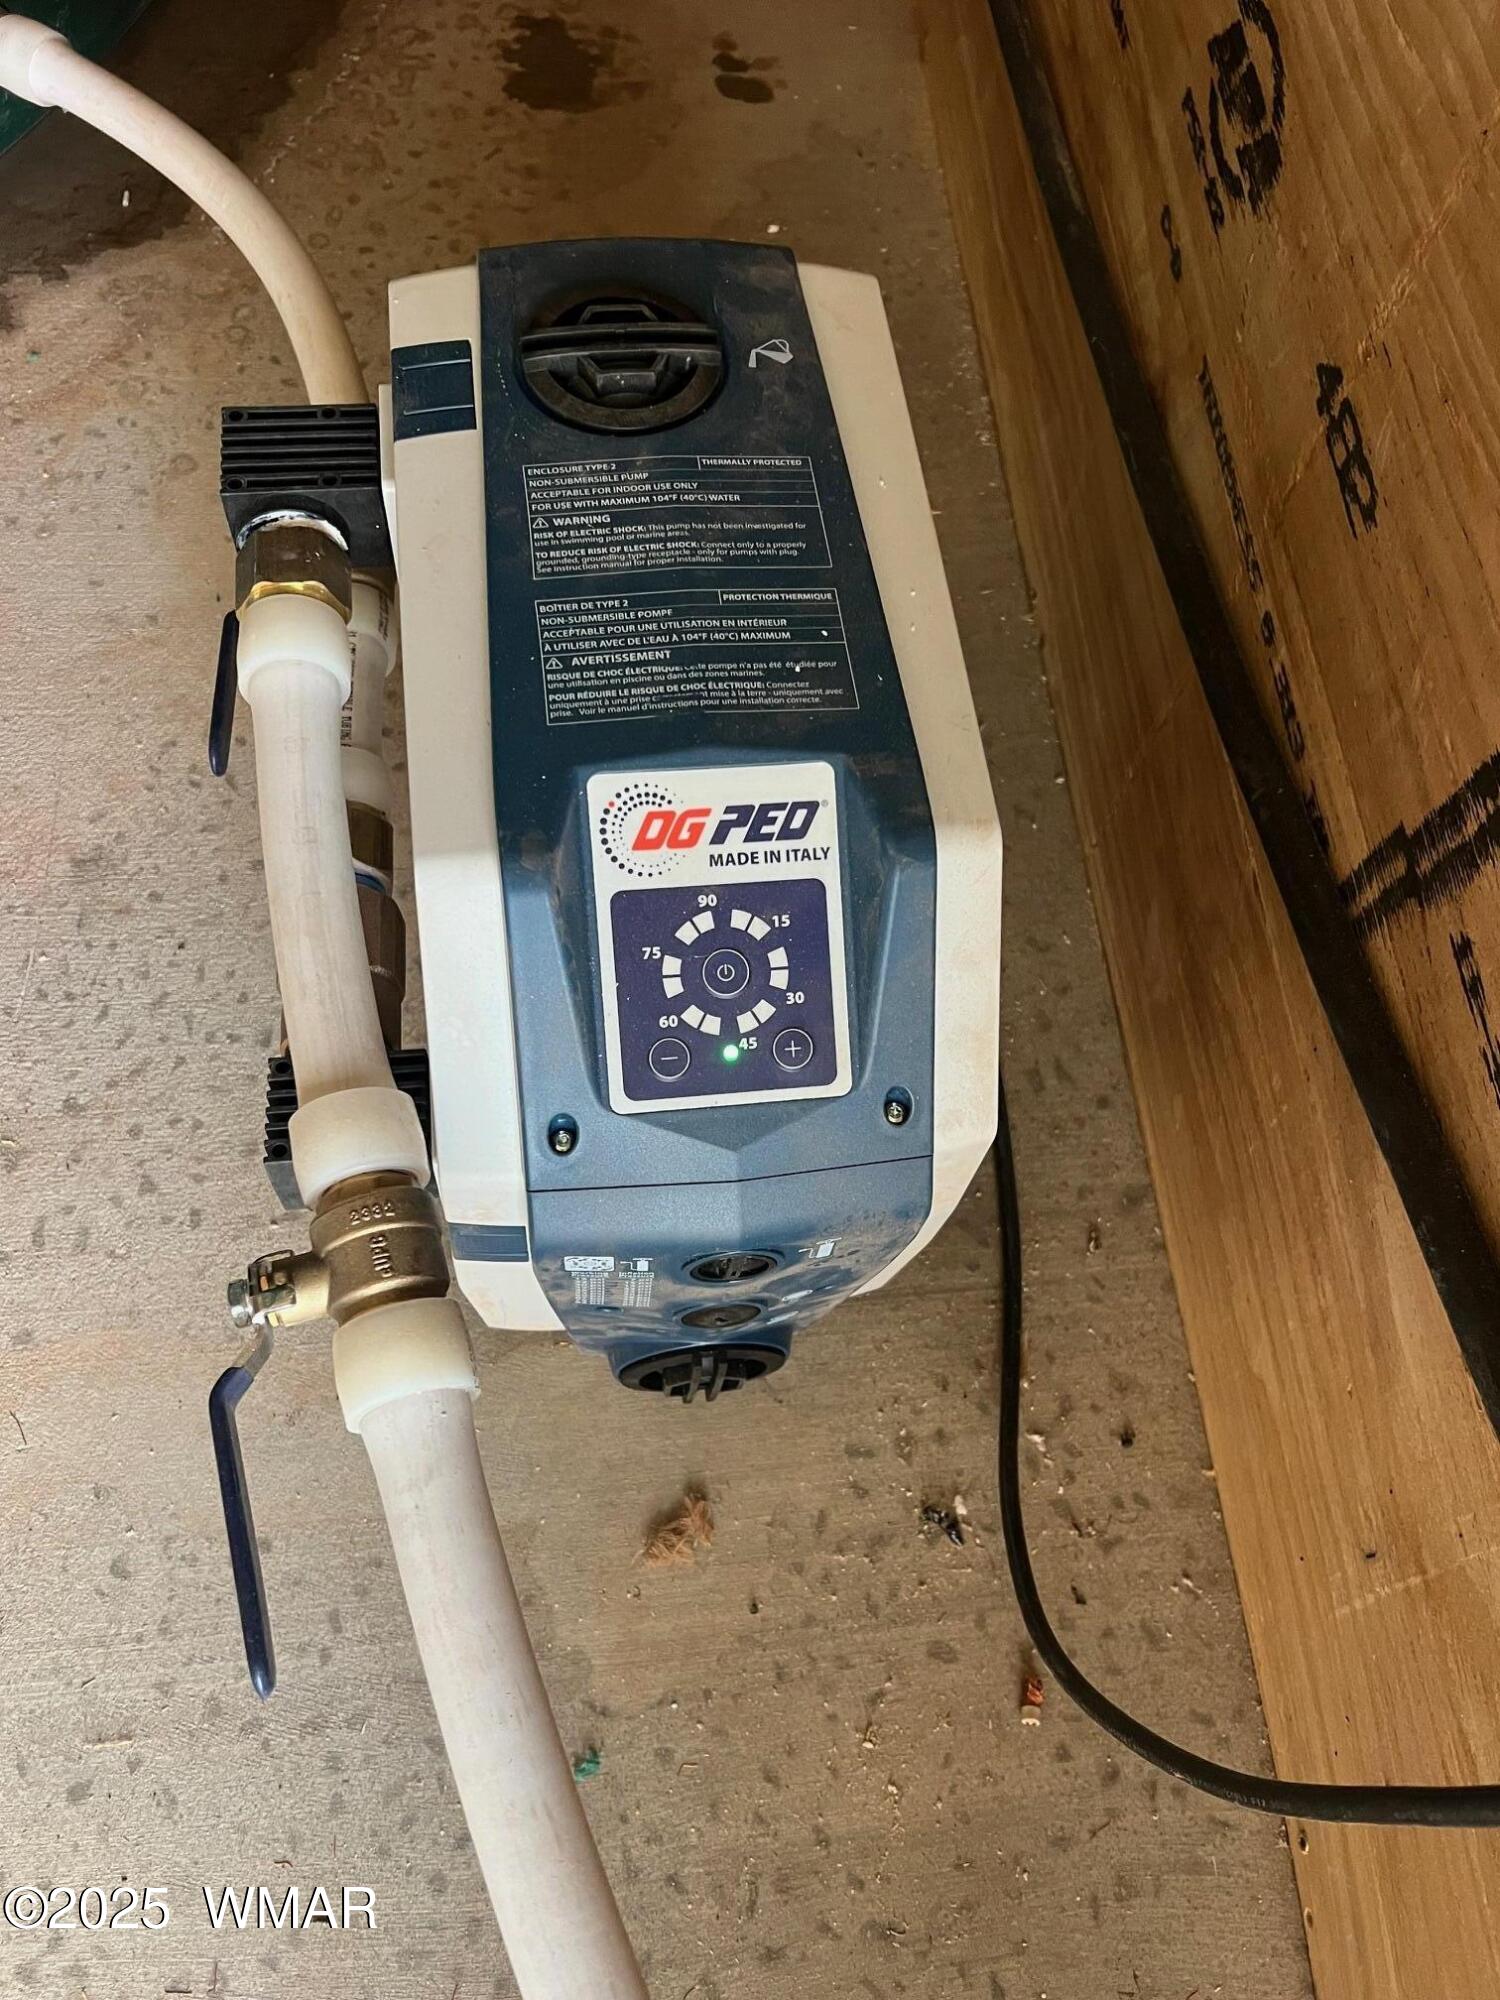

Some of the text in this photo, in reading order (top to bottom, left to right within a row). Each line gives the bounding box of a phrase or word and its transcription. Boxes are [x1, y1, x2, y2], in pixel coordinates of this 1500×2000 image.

[527, 465, 583, 476] ENCLOSURE
[585, 463, 608, 472] TYPE
[701, 458, 751, 466] THERMALLY
[528, 472, 649, 487] NON-SUBMERSIBLE PUMP
[530, 488, 590, 499] ACCEPTABLE
[592, 487, 611, 495] FOR
[613, 483, 651, 493] INDOOR
[653, 482, 671, 490] USE
[532, 503, 551, 511] FOR
[553, 501, 572, 509] USE
[573, 499, 599, 508] WITH
[600, 496, 650, 506] MAXIMUM
[652, 494, 678, 502] 104°F
[680, 494, 707, 502] (40°C)
[552, 515, 611, 526] WARNING
[533, 531, 554, 539] RISK
[556, 530, 568, 538] OF
[570, 528, 611, 537] ELECTRIC
[613, 525, 647, 534] SHOCK:
[648, 523, 664, 531] This
[745, 522, 793, 531] investigated
[561, 535, 604, 546] swimming
[605, 533, 624, 543] pool
[637, 530, 665, 539] marine
[535, 551, 548, 559] TO
[549, 548, 586, 558] REDUCE
[587, 547, 607, 555] RISK
[623, 542, 665, 552] ELECTRIC
[666, 541, 700, 549] SHOCK:
[740, 541, 754, 550] only
[772, 541, 806, 550] properly
[536, 556, 579, 567] grounded,
[696, 548, 714, 557] only
[536, 565, 551, 573] See
[553, 562, 599, 572] instruction
[601, 560, 632, 569] manual
[647, 557, 674, 567] proper
[722, 593, 780, 601] PROTECTION
[539, 603, 578, 613] BOÎTIER
[580, 602, 594, 610] DE
[595, 600, 620, 609] TYPE
[541, 612, 636, 626] NON-SUBMERSIBLE
[542, 627, 605, 639] ACCEPTABLE
[607, 625, 635, 634] POUR
[637, 623, 658, 632] UNE
[660, 620, 720, 630] UTILISATION
[737, 617, 787, 627] INTÉRIEUR
[544, 643, 552, 652] À
[554, 641, 597, 651] UTILISER
[599, 639, 625, 648] AVEC
[627, 637, 641, 645] DE
[643, 635, 669, 644] L'EAU
[672, 633, 679, 642] À
[681, 633, 707, 641] 104°F
[740, 632, 791, 640] MAXIMUM
[571, 651, 671, 666] AVERTISSEMENT
[547, 672, 580, 680] RISQUE
[597, 669, 623, 678] CHOC
[707, 663, 737, 671] pompe
[753, 662, 767, 670] pas
[818, 661, 837, 669] pour
[566, 678, 608, 688] utilisation
[622, 674, 652, 685] piscine
[667, 671, 686, 680] dans
[688, 670, 703, 678] des
[548, 693, 576, 701] POUR
[577, 690, 616, 700] RÉDUIRE
[632, 686, 665, 695] RISQUE
[666, 685, 679, 693] DE
[681, 683, 707, 691] CHOC
[549, 699, 602, 711] uniquement
[630, 695, 650, 705] prise
[773, 688, 823, 697] uniquement
[578, 707, 595, 715] Voir
[607, 703, 640, 713] manuel
[700, 699, 719, 707] pour
[709, 847, 831, 867] MADE IN ITALY
[697, 894, 718, 908] 90
[771, 915, 791, 928] 15
[642, 947, 661, 959] 75
[785, 992, 805, 1004] 30
[659, 1015, 679, 1028] 60
[739, 1037, 758, 1050] 45
